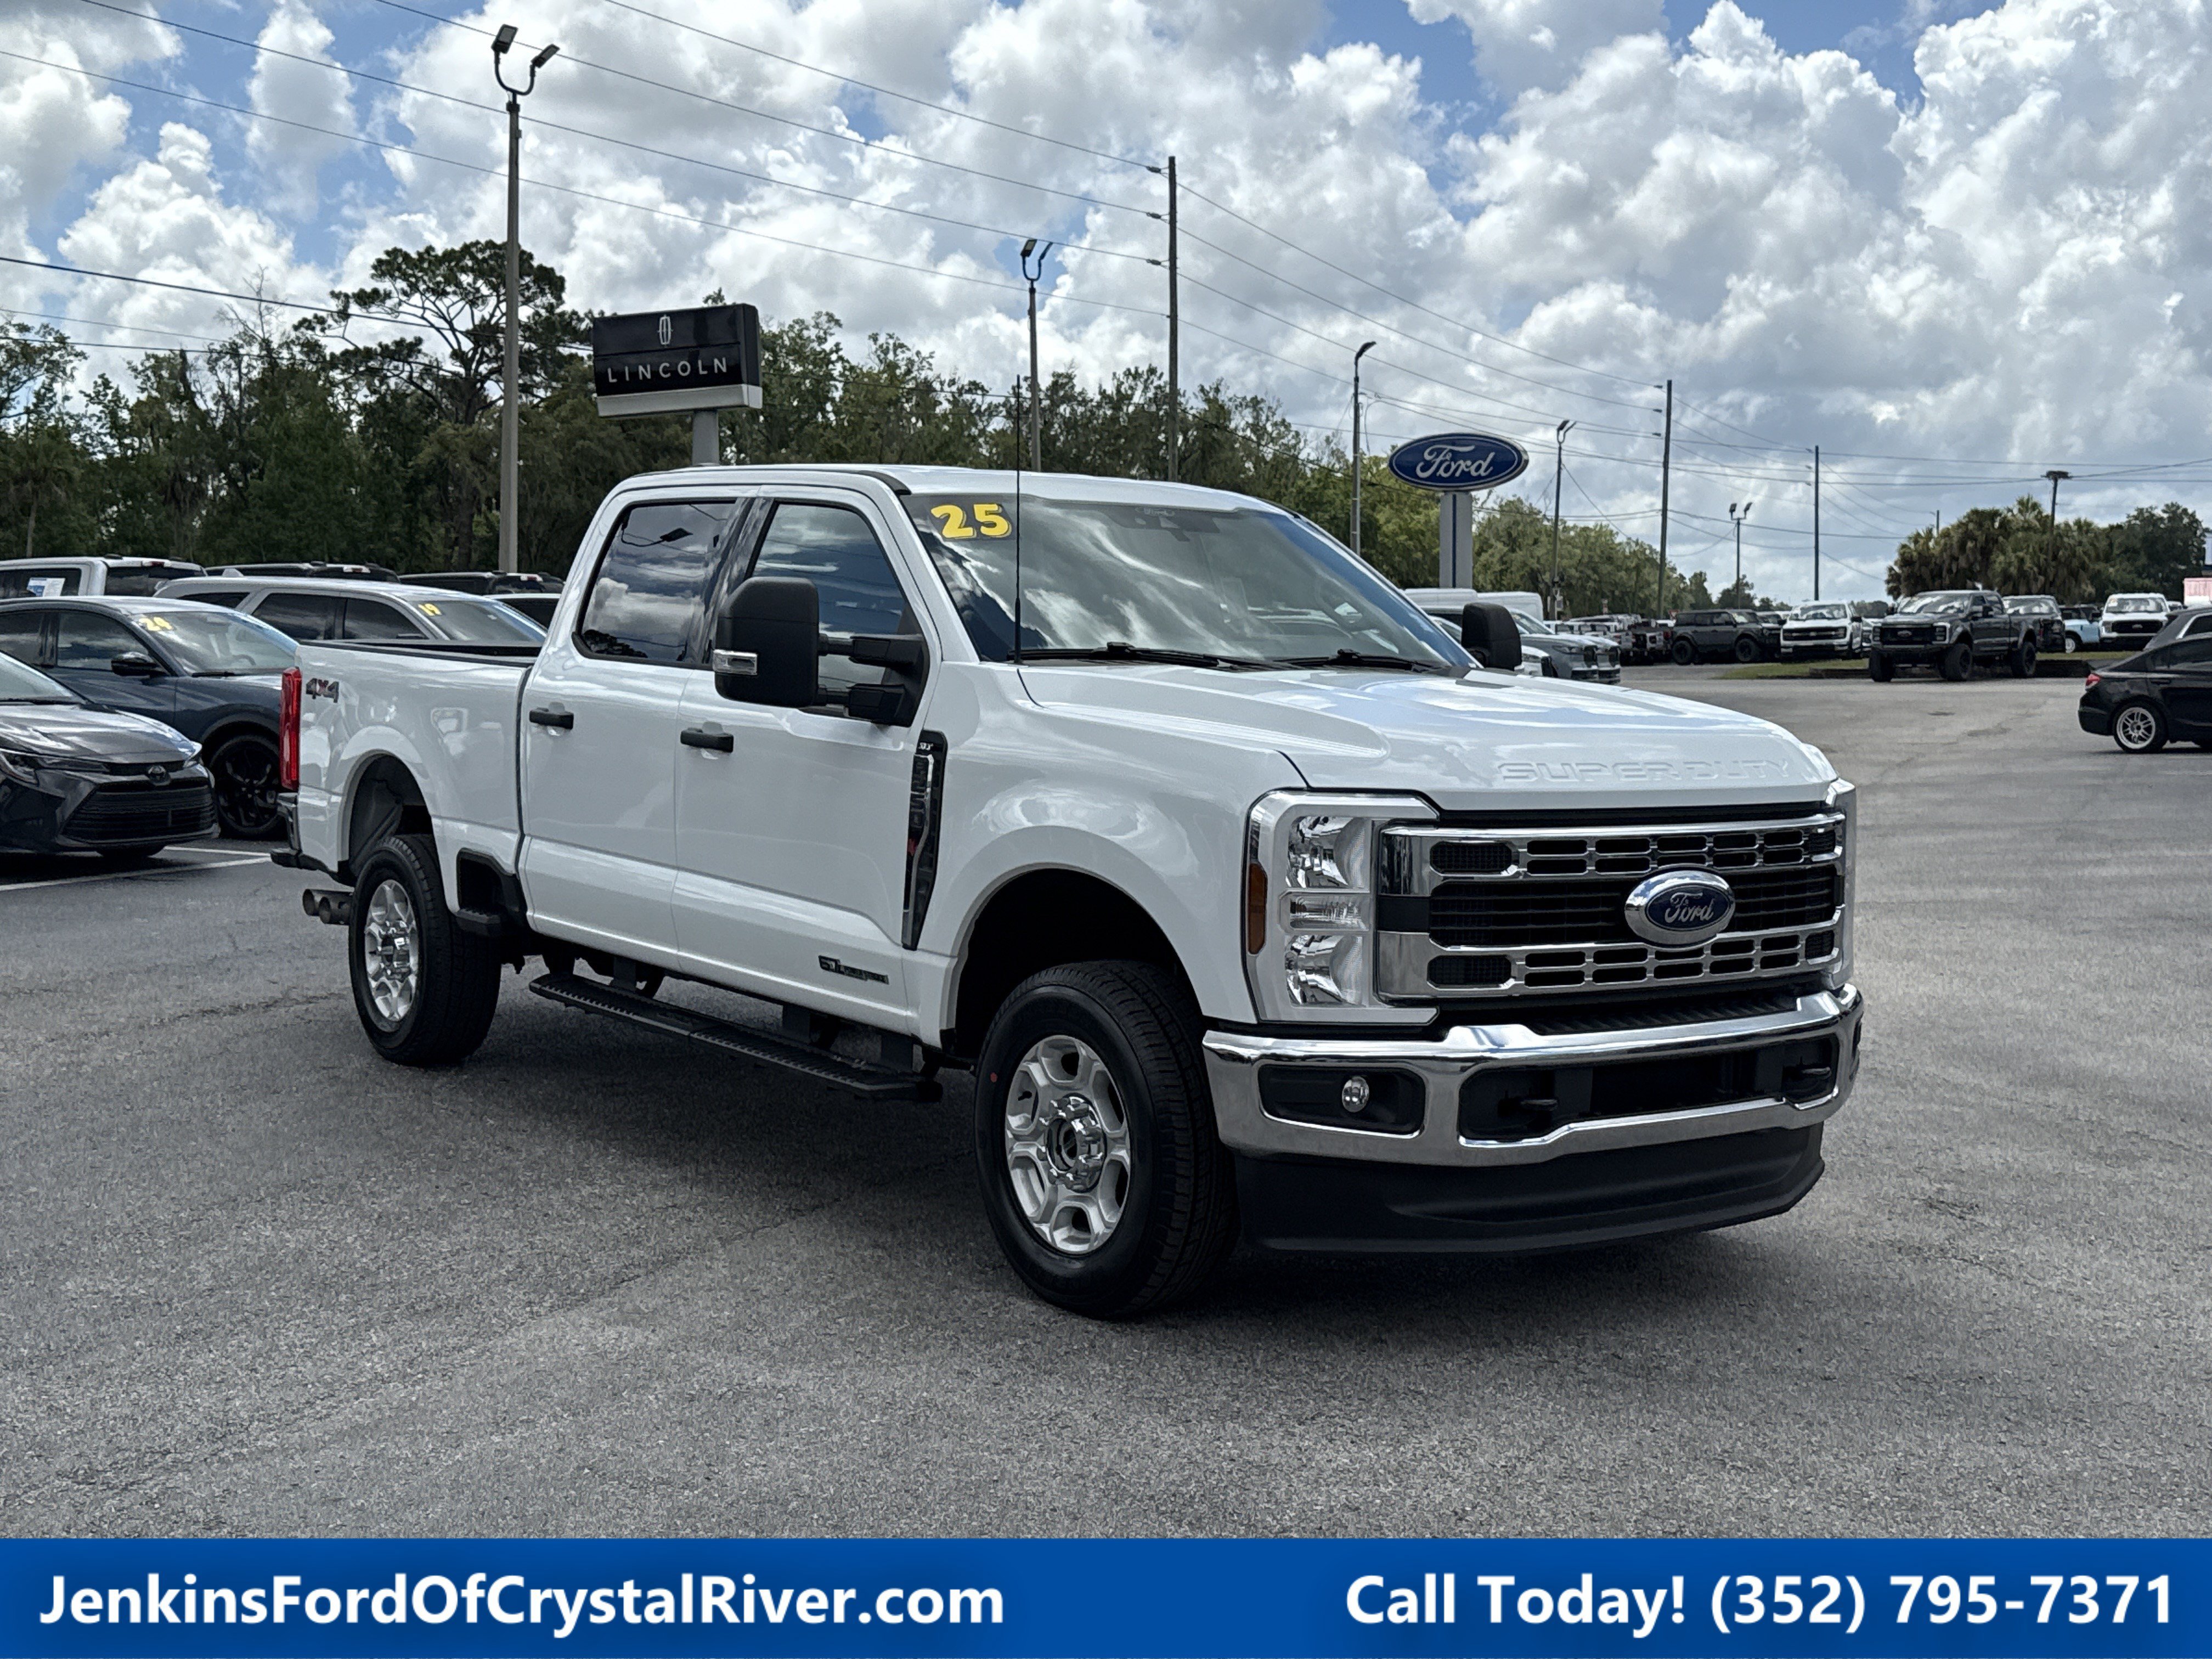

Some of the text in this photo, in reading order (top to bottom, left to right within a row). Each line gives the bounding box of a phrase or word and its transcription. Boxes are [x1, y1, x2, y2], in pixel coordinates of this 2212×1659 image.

[607, 357, 727, 383] LINCOLN
[1415, 444, 1495, 478] Ford
[930, 503, 1012, 538] 25
[1497, 759, 1790, 782] SUPER DUTY
[1664, 891, 1716, 924] Ford
